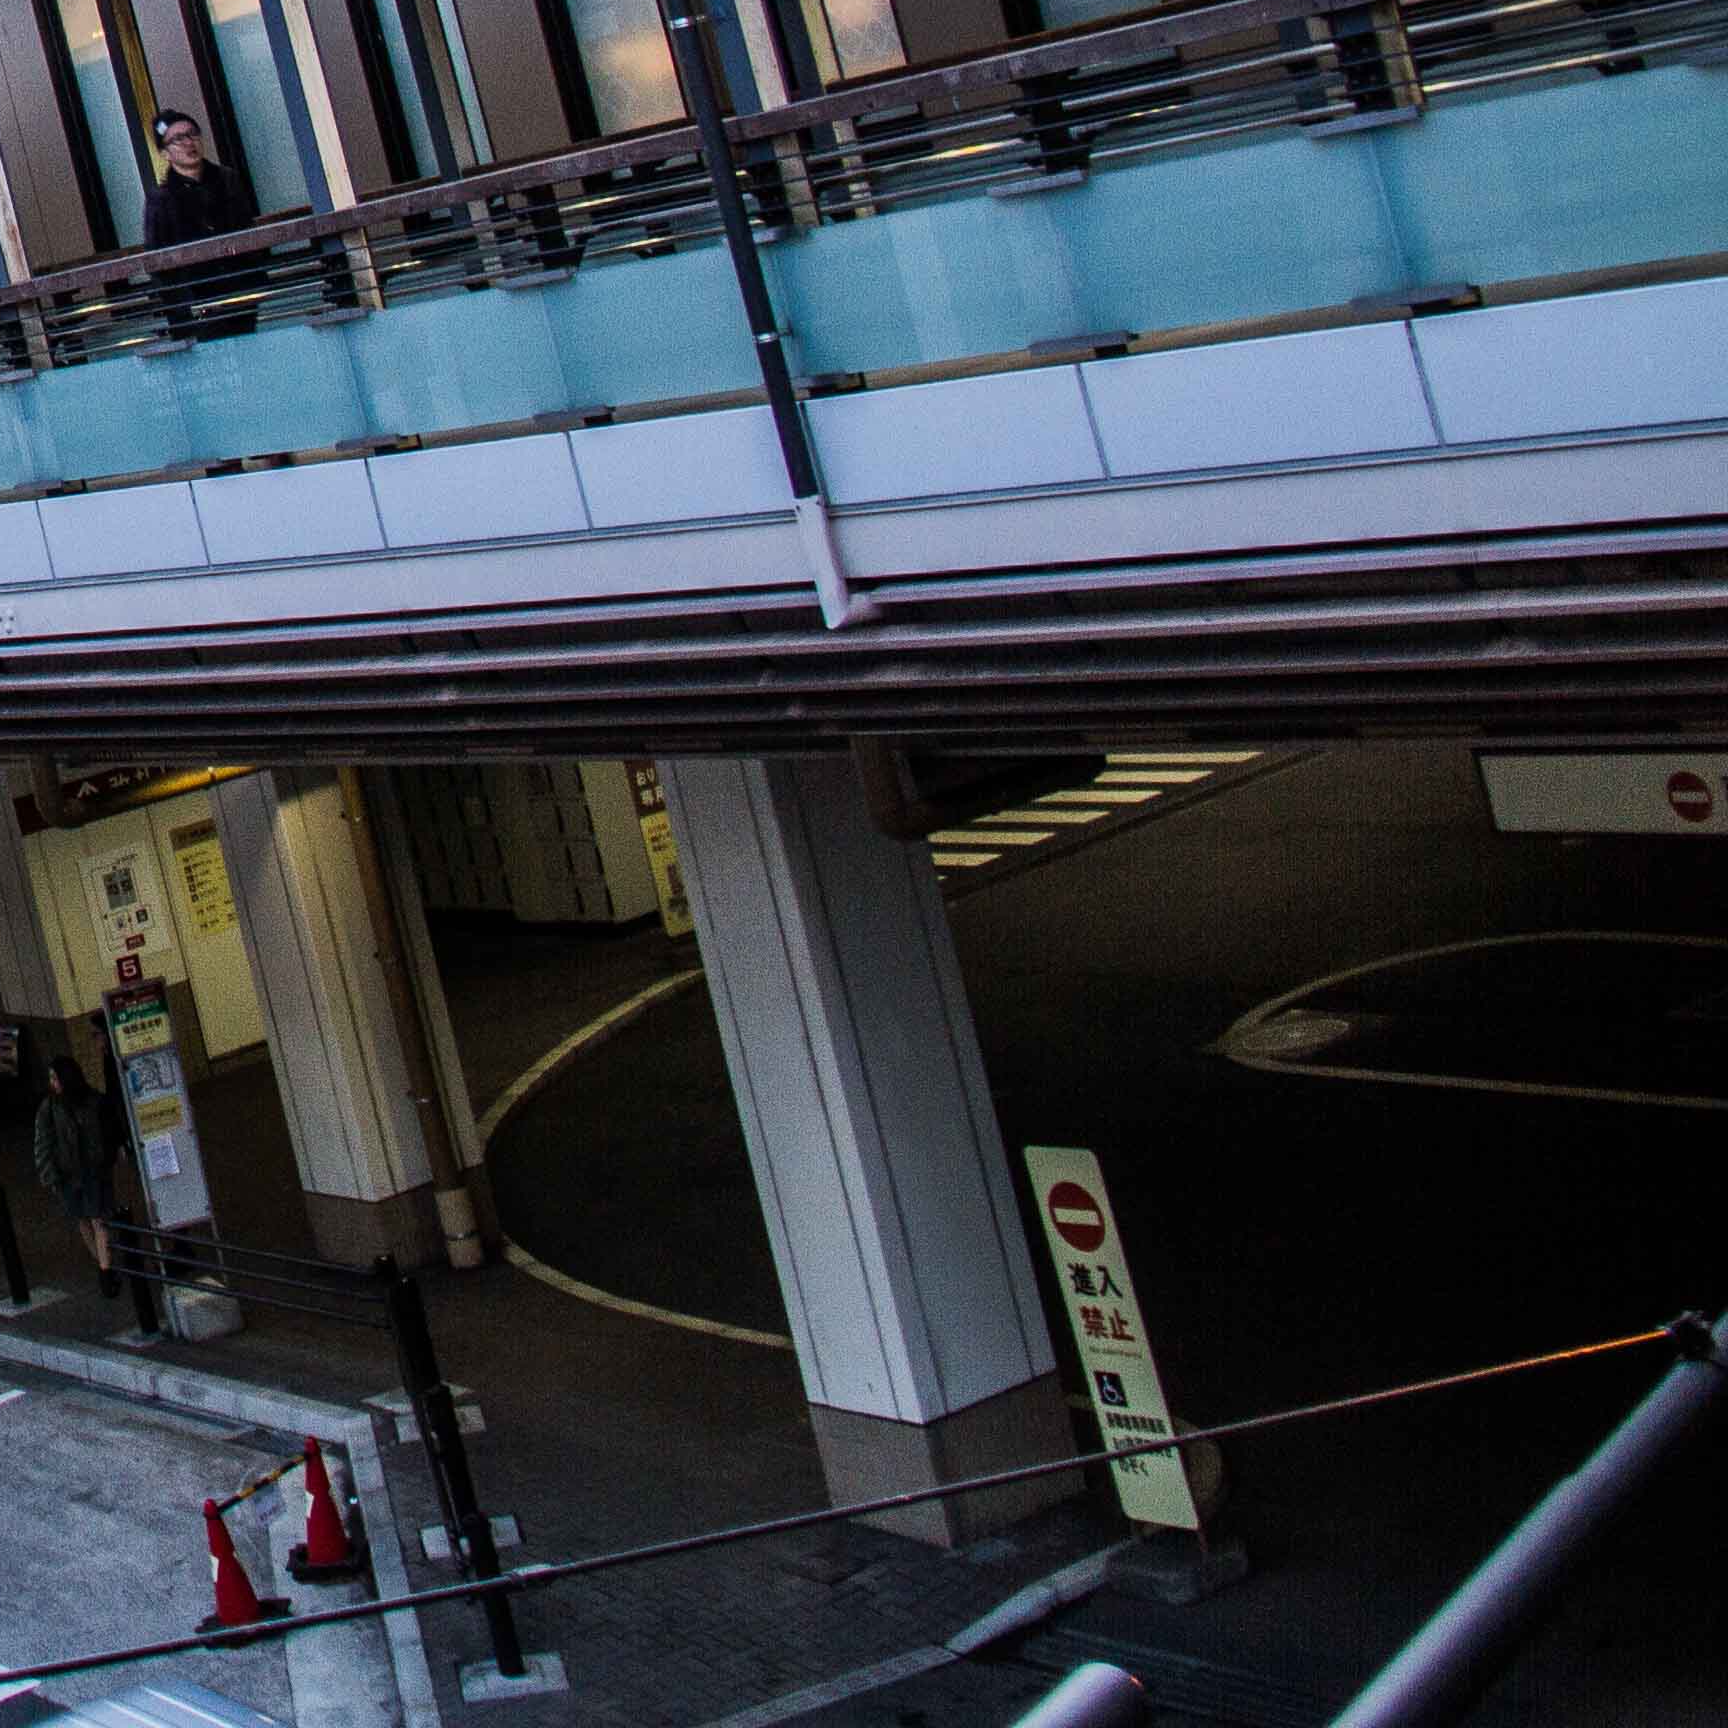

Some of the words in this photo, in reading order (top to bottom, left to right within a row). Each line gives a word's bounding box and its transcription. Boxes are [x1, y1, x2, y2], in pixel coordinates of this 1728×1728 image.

[121, 960, 137, 977] 5
[1068, 1262, 1123, 1299] 進入
[1079, 1306, 1136, 1342] 禁止
